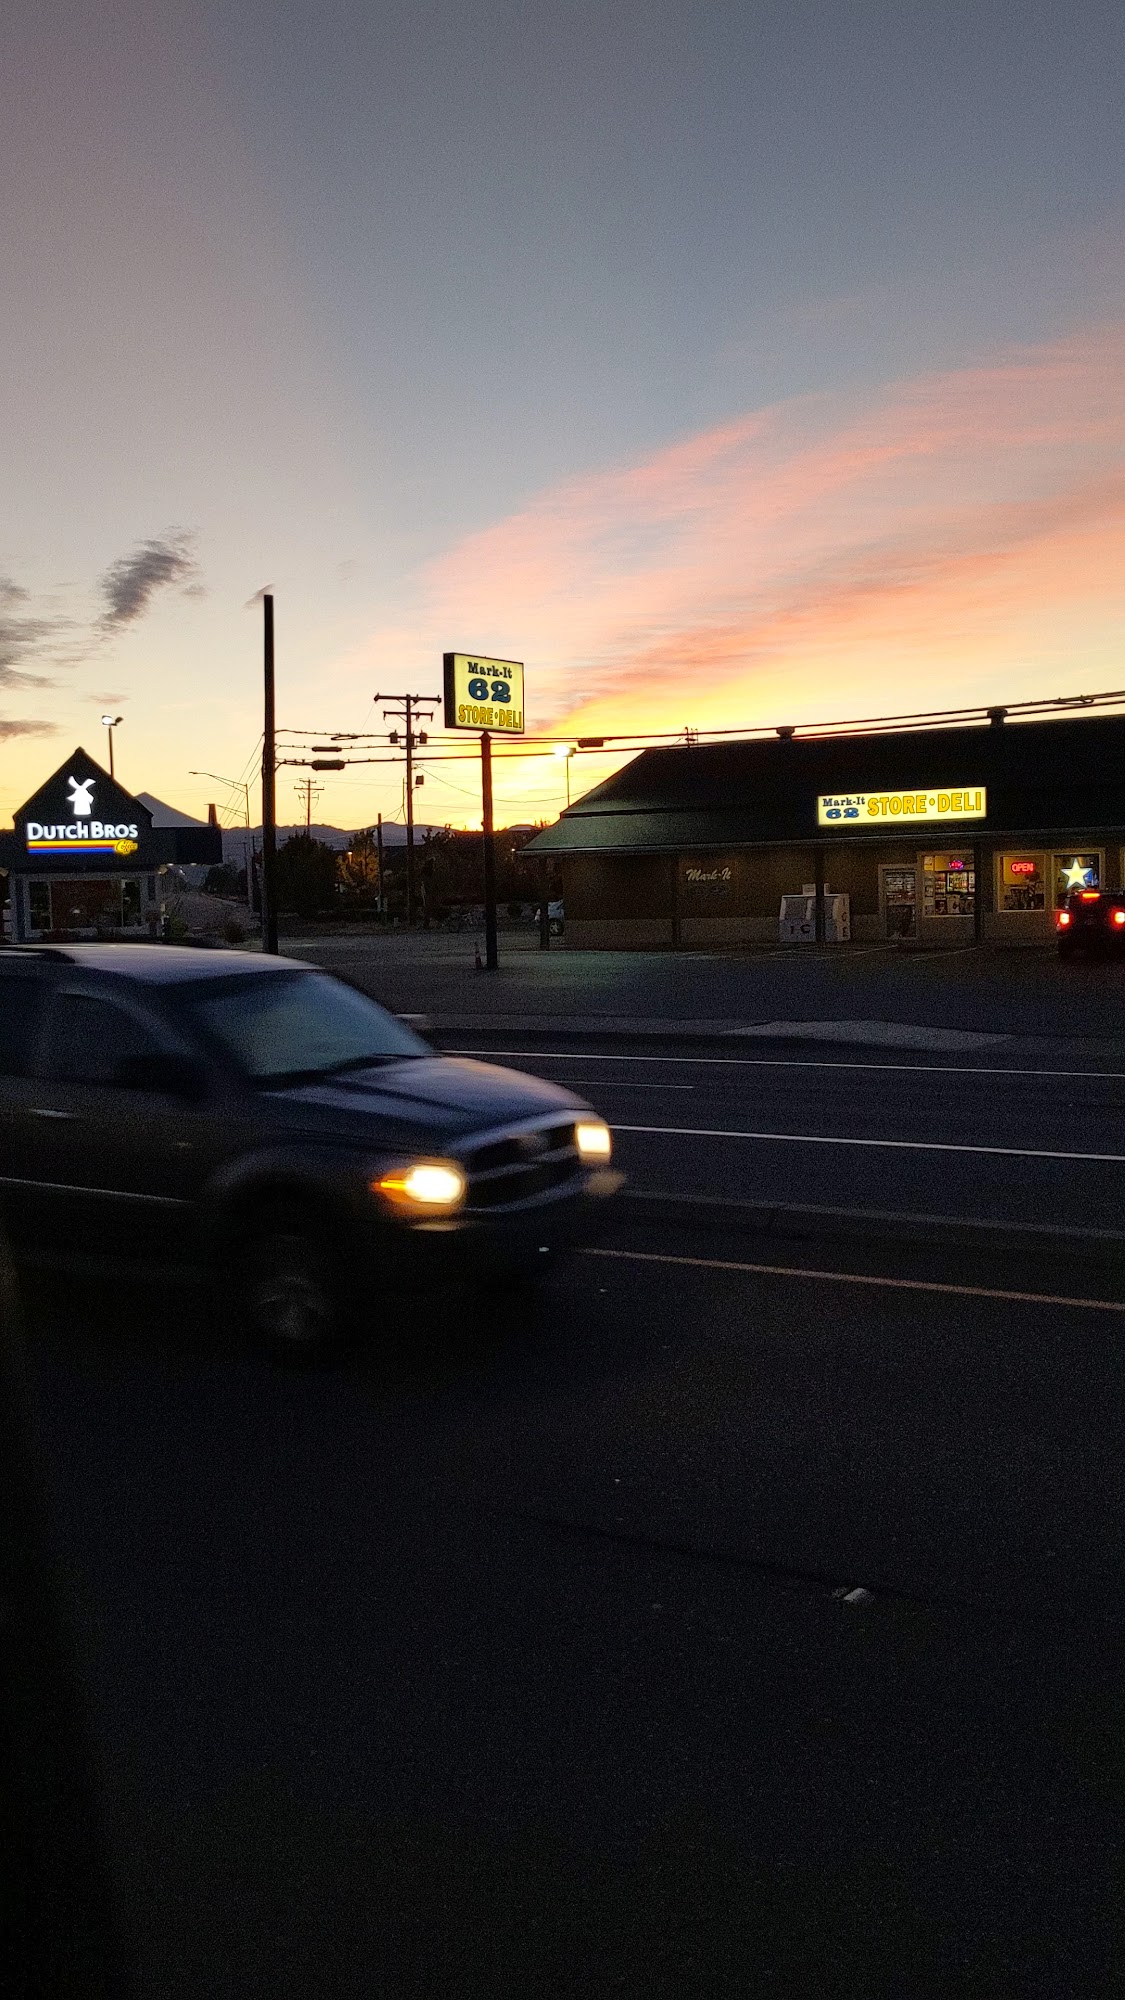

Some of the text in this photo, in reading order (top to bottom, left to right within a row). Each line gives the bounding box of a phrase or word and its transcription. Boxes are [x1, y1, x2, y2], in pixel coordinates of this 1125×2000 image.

[468, 678, 512, 703] 62
[458, 704, 522, 729] STORE DELI
[826, 807, 860, 819] 62
[867, 791, 982, 816] STORE DELI
[90, 821, 138, 839] BROS
[1011, 863, 1034, 872] OPEN
